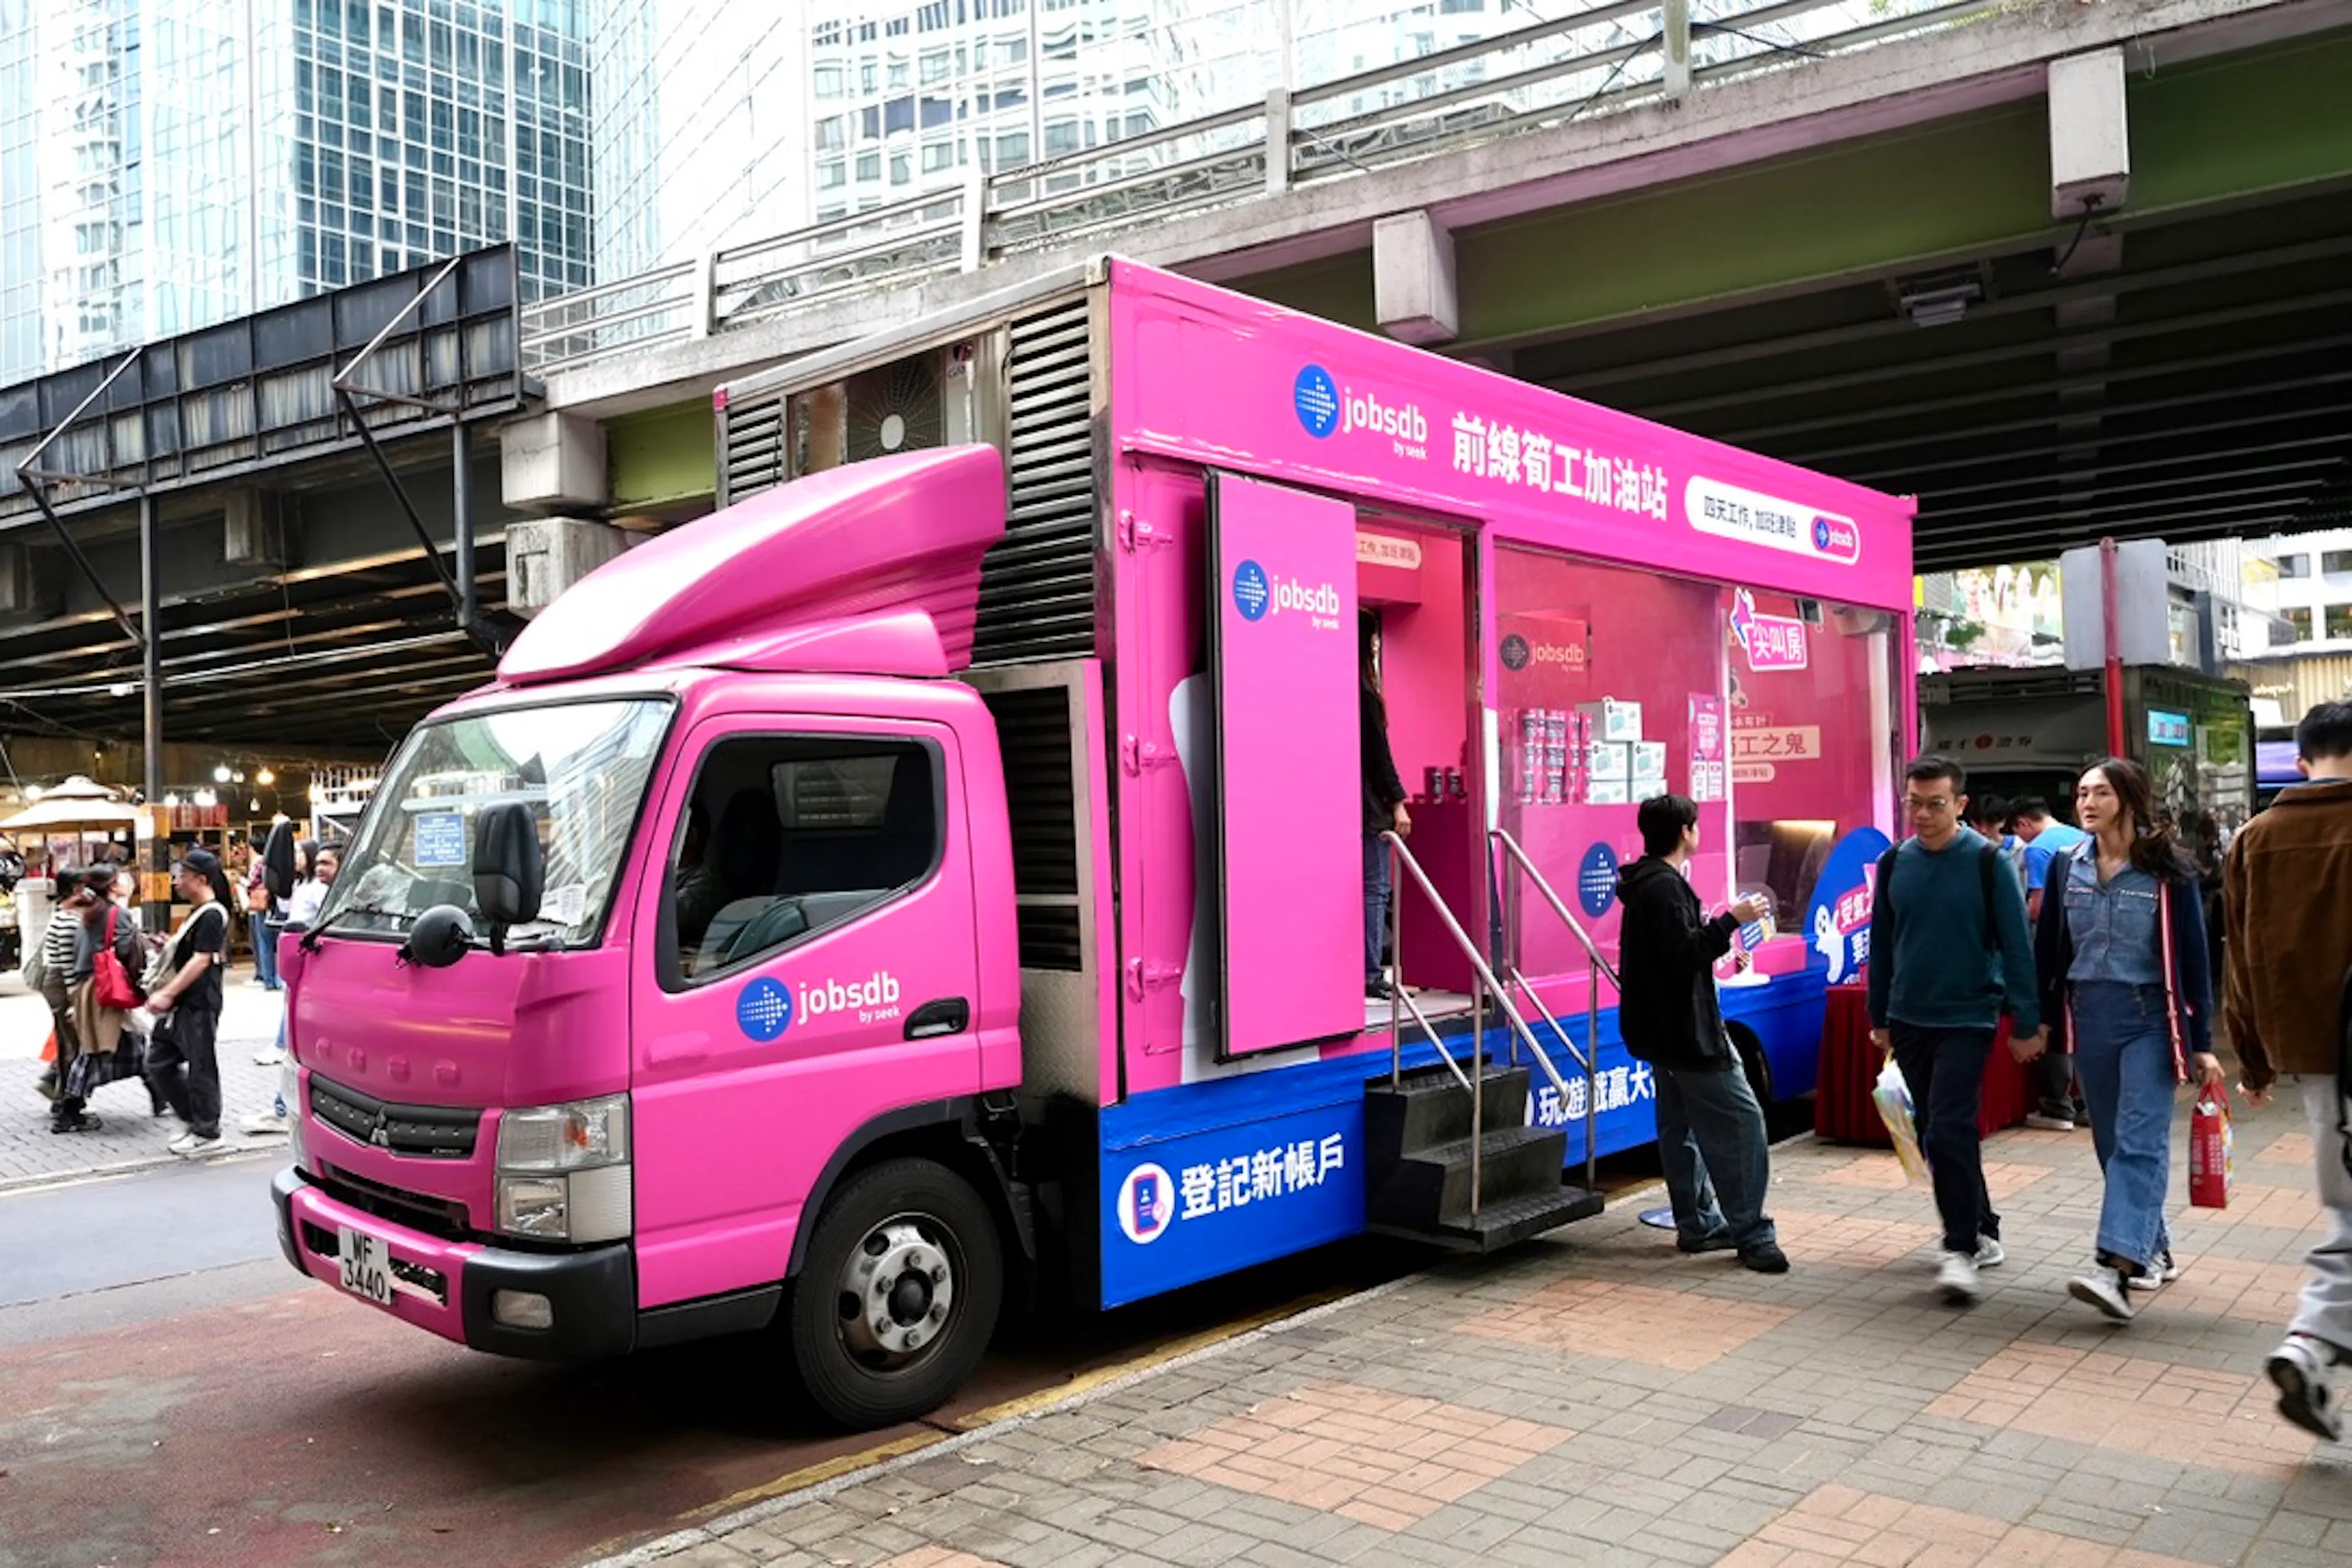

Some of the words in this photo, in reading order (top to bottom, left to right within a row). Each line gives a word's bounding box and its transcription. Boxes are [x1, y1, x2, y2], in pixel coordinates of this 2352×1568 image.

[1343, 386, 1428, 442] jobsdb
[1452, 411, 1668, 521] 前線筍工加油站
[1272, 575, 1340, 615] jobsdb
[1531, 641, 1584, 666] jobsdb
[1754, 622, 1803, 662] 尖叫房
[1732, 733, 1807, 756] 工之鬼
[798, 972, 900, 1025] jobsdb
[859, 1010, 872, 1023] by
[1180, 1132, 1344, 1220] 登記新帳戶
[344, 1257, 385, 1300] 3440
